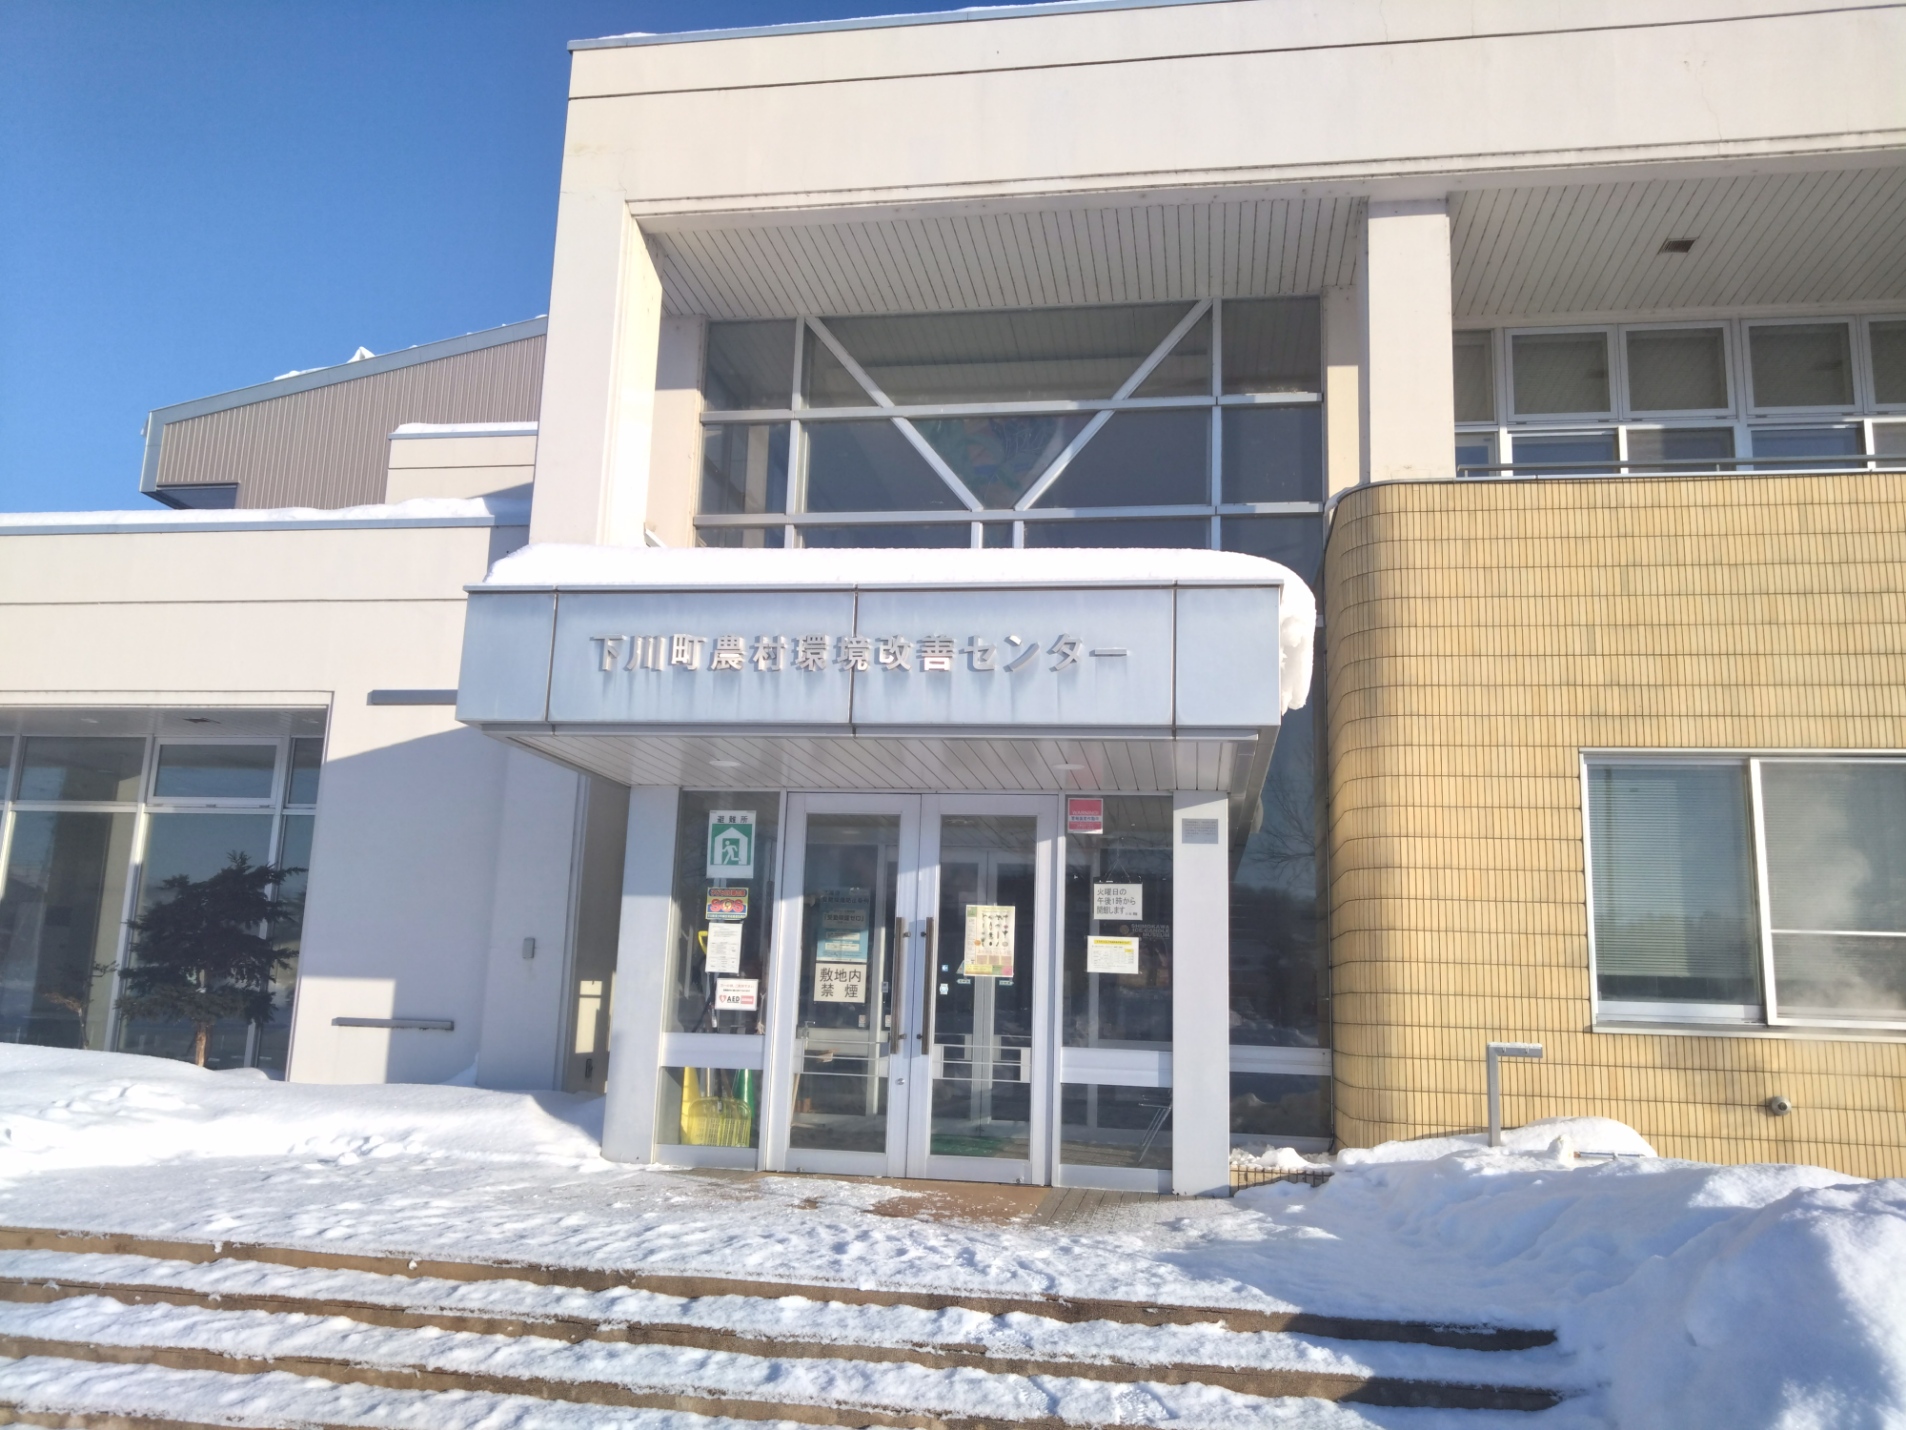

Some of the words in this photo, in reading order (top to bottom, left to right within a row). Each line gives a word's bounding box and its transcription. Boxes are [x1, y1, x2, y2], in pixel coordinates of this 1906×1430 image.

[591, 633, 1128, 672] 下川町農村環境改善センター
[716, 815, 749, 824] 避難所
[1096, 887, 1127, 896] 火曜日の
[709, 898, 744, 912] SOS
[1096, 897, 1136, 906] 午後1時から
[819, 967, 862, 983] 敷地内
[820, 983, 859, 998] 禁煙
